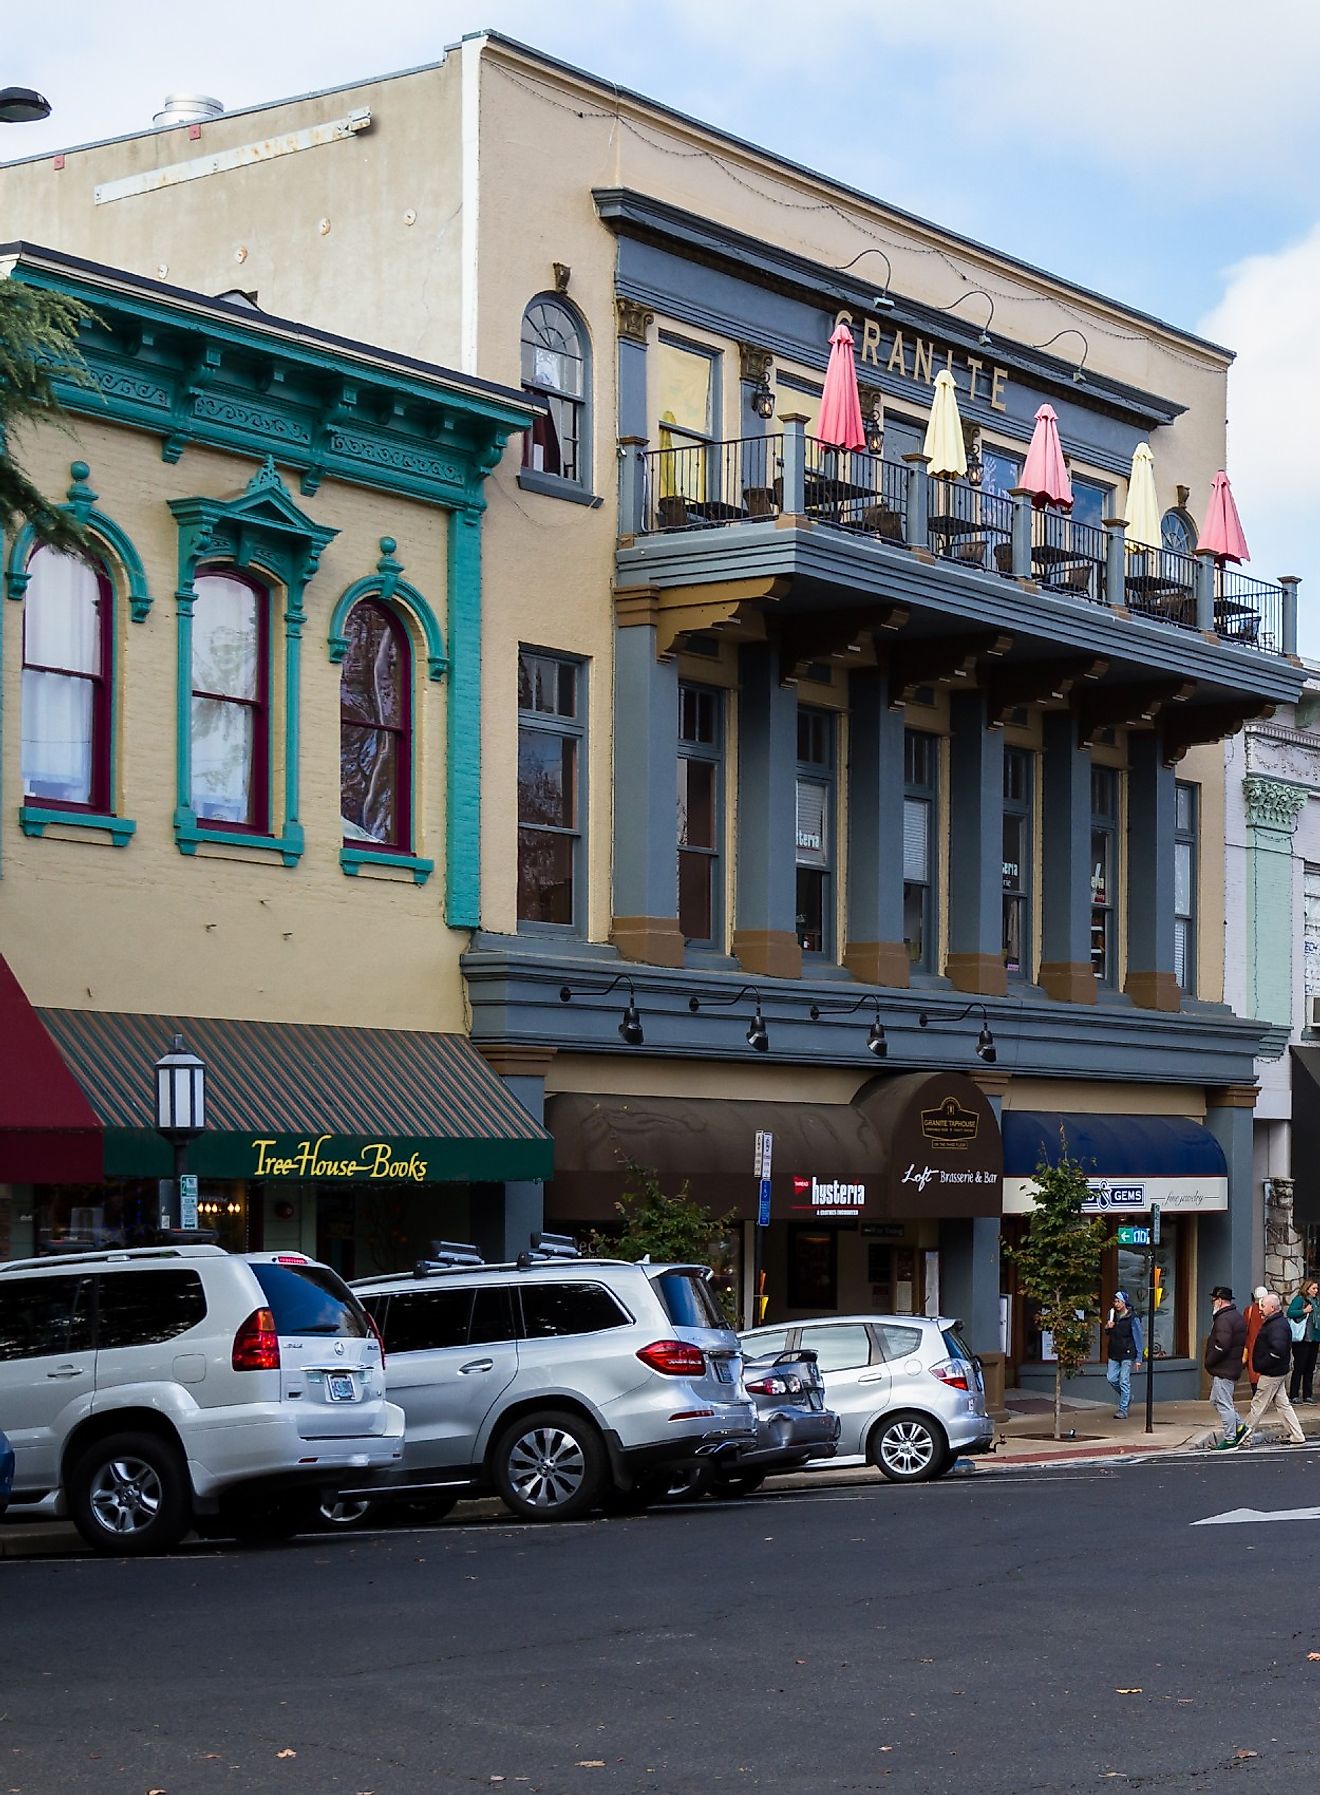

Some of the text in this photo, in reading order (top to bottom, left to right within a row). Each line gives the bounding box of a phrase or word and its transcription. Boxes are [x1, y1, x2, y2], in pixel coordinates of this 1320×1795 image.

[361, 1143, 428, 1182] Books
[811, 1176, 865, 1205] hysteria
[902, 1163, 998, 1192] Loft Brasserie & Bar
[1114, 1190, 1142, 1201] GEMS
